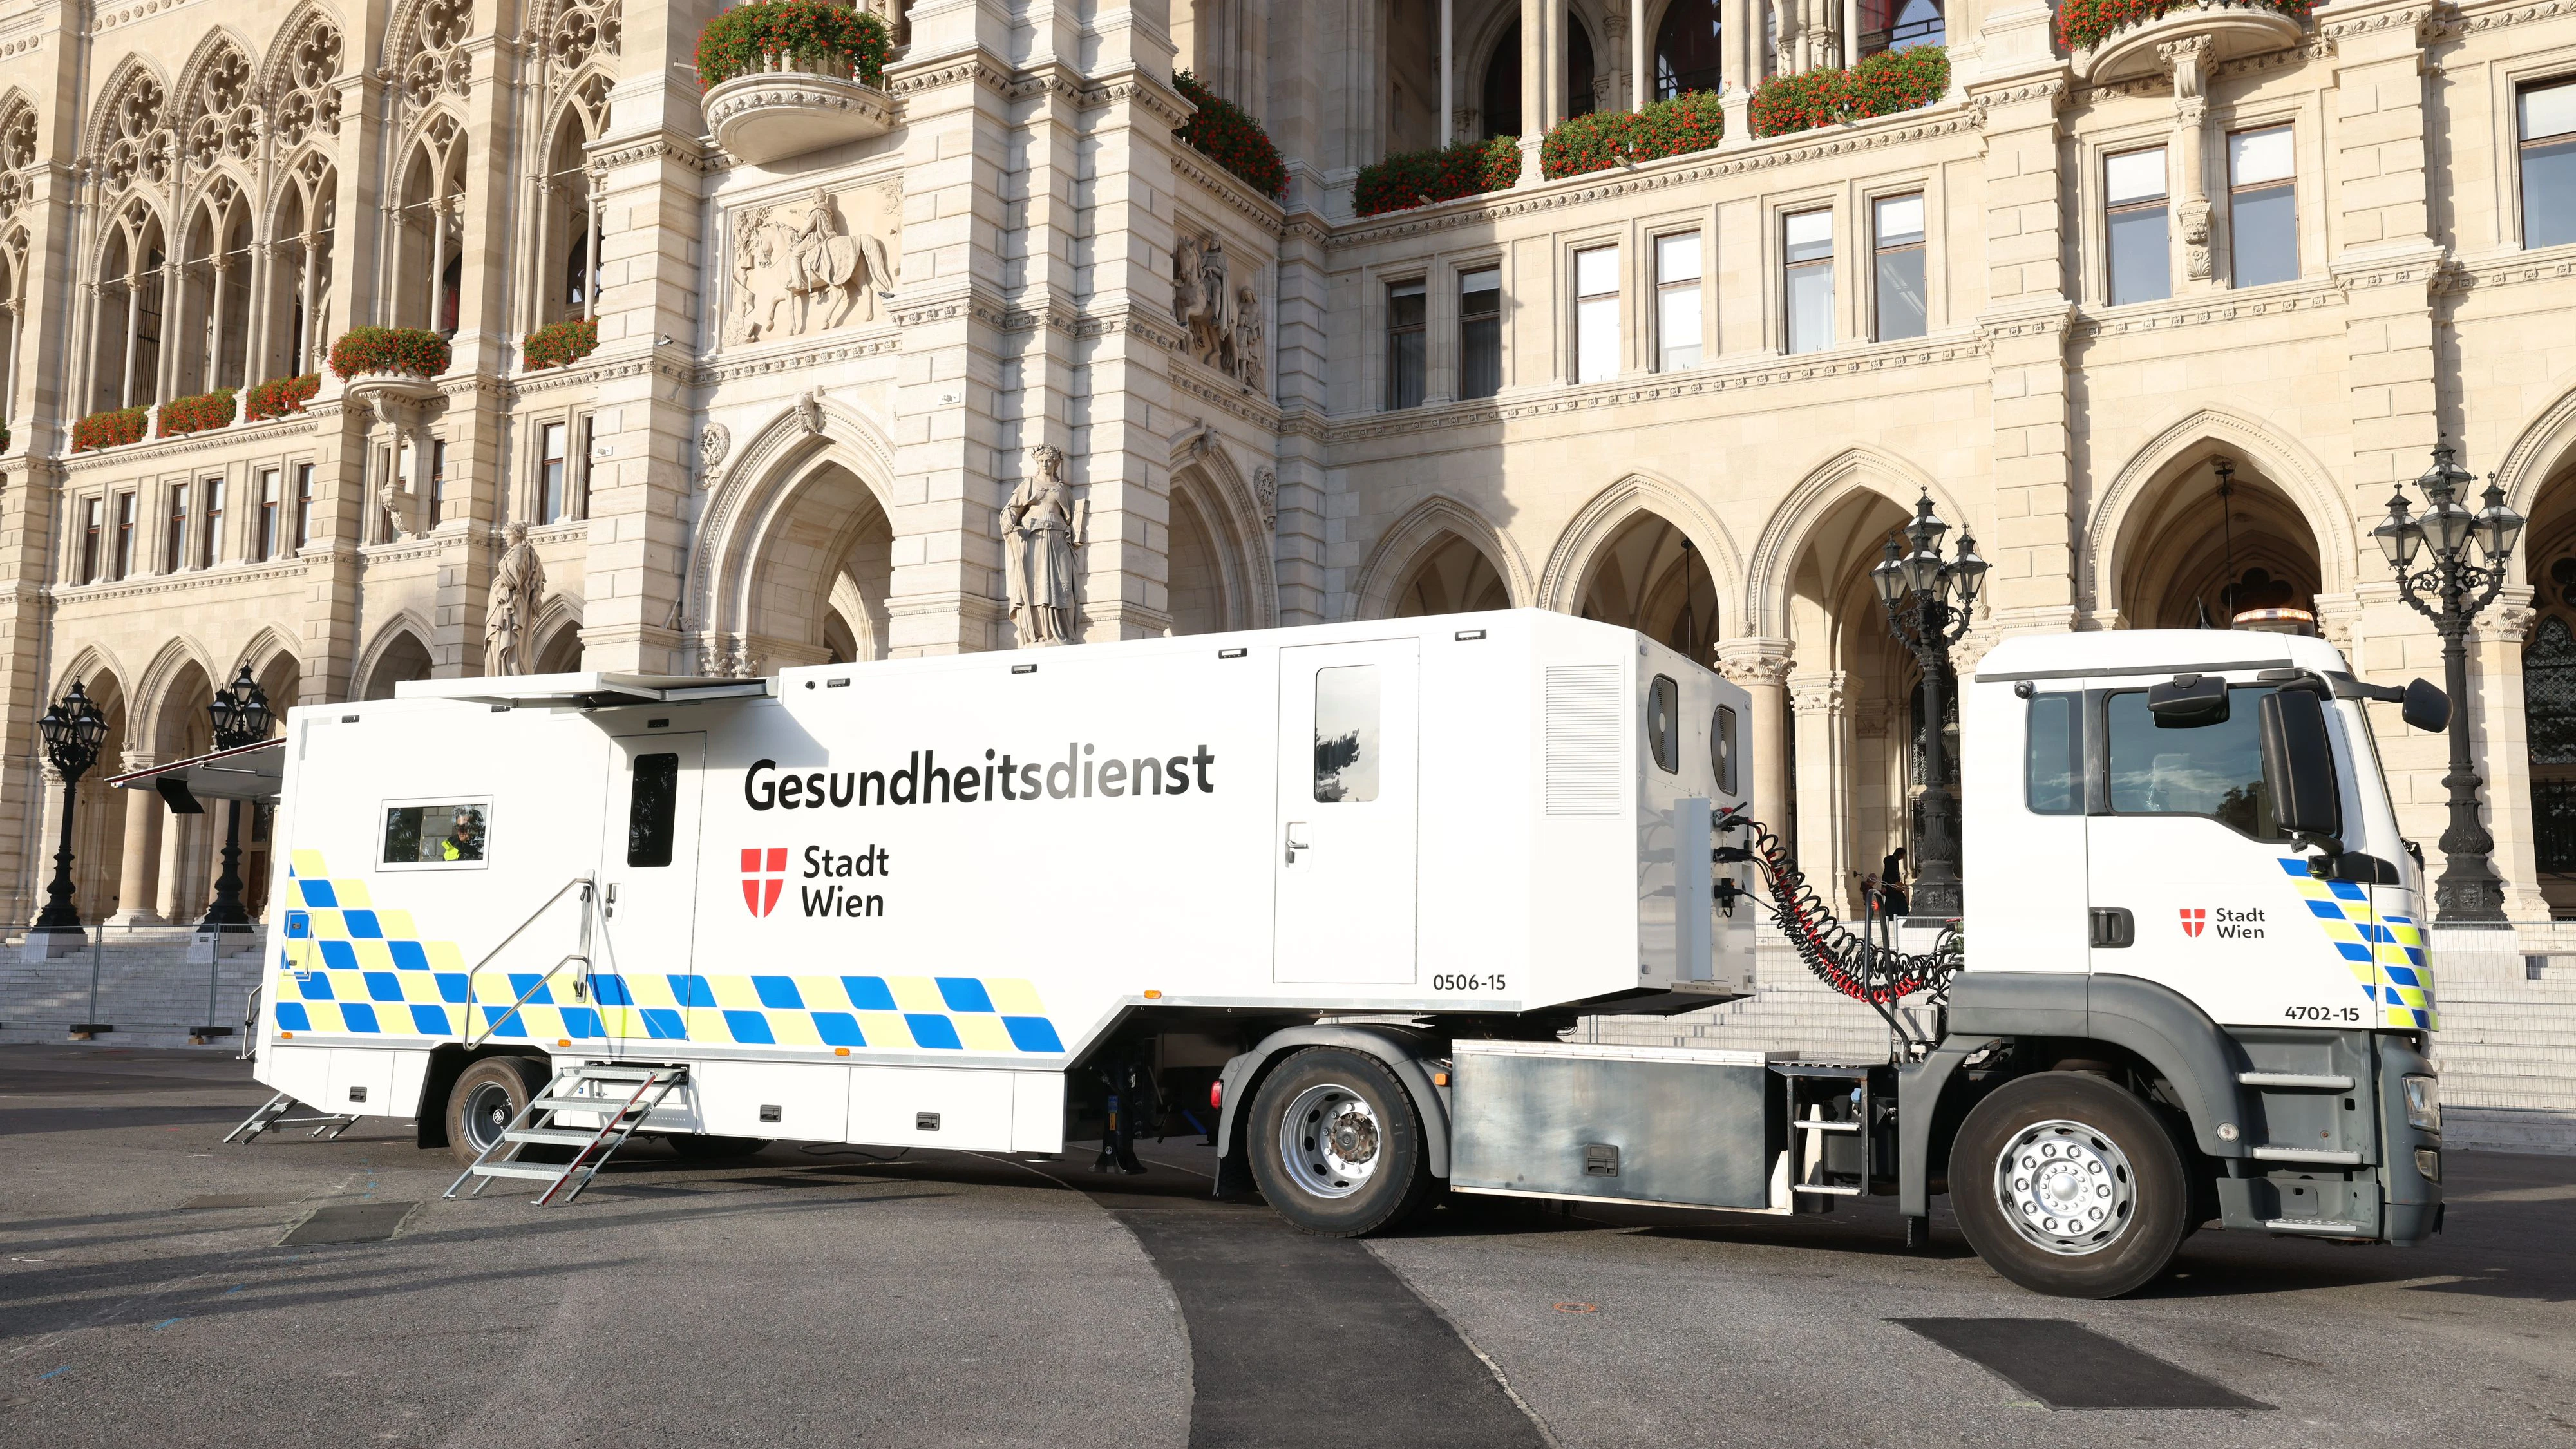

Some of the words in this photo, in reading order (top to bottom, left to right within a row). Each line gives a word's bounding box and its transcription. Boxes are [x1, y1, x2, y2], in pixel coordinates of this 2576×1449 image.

[745, 741, 1216, 811] Gesundheitsdienst
[803, 844, 889, 878] Stadt
[802, 885, 884, 918] Wien
[2216, 907, 2266, 922] Stadt
[2217, 924, 2264, 938] Wien
[1433, 974, 1506, 991] 0506-15
[2284, 1006, 2360, 1021] 4702-15
